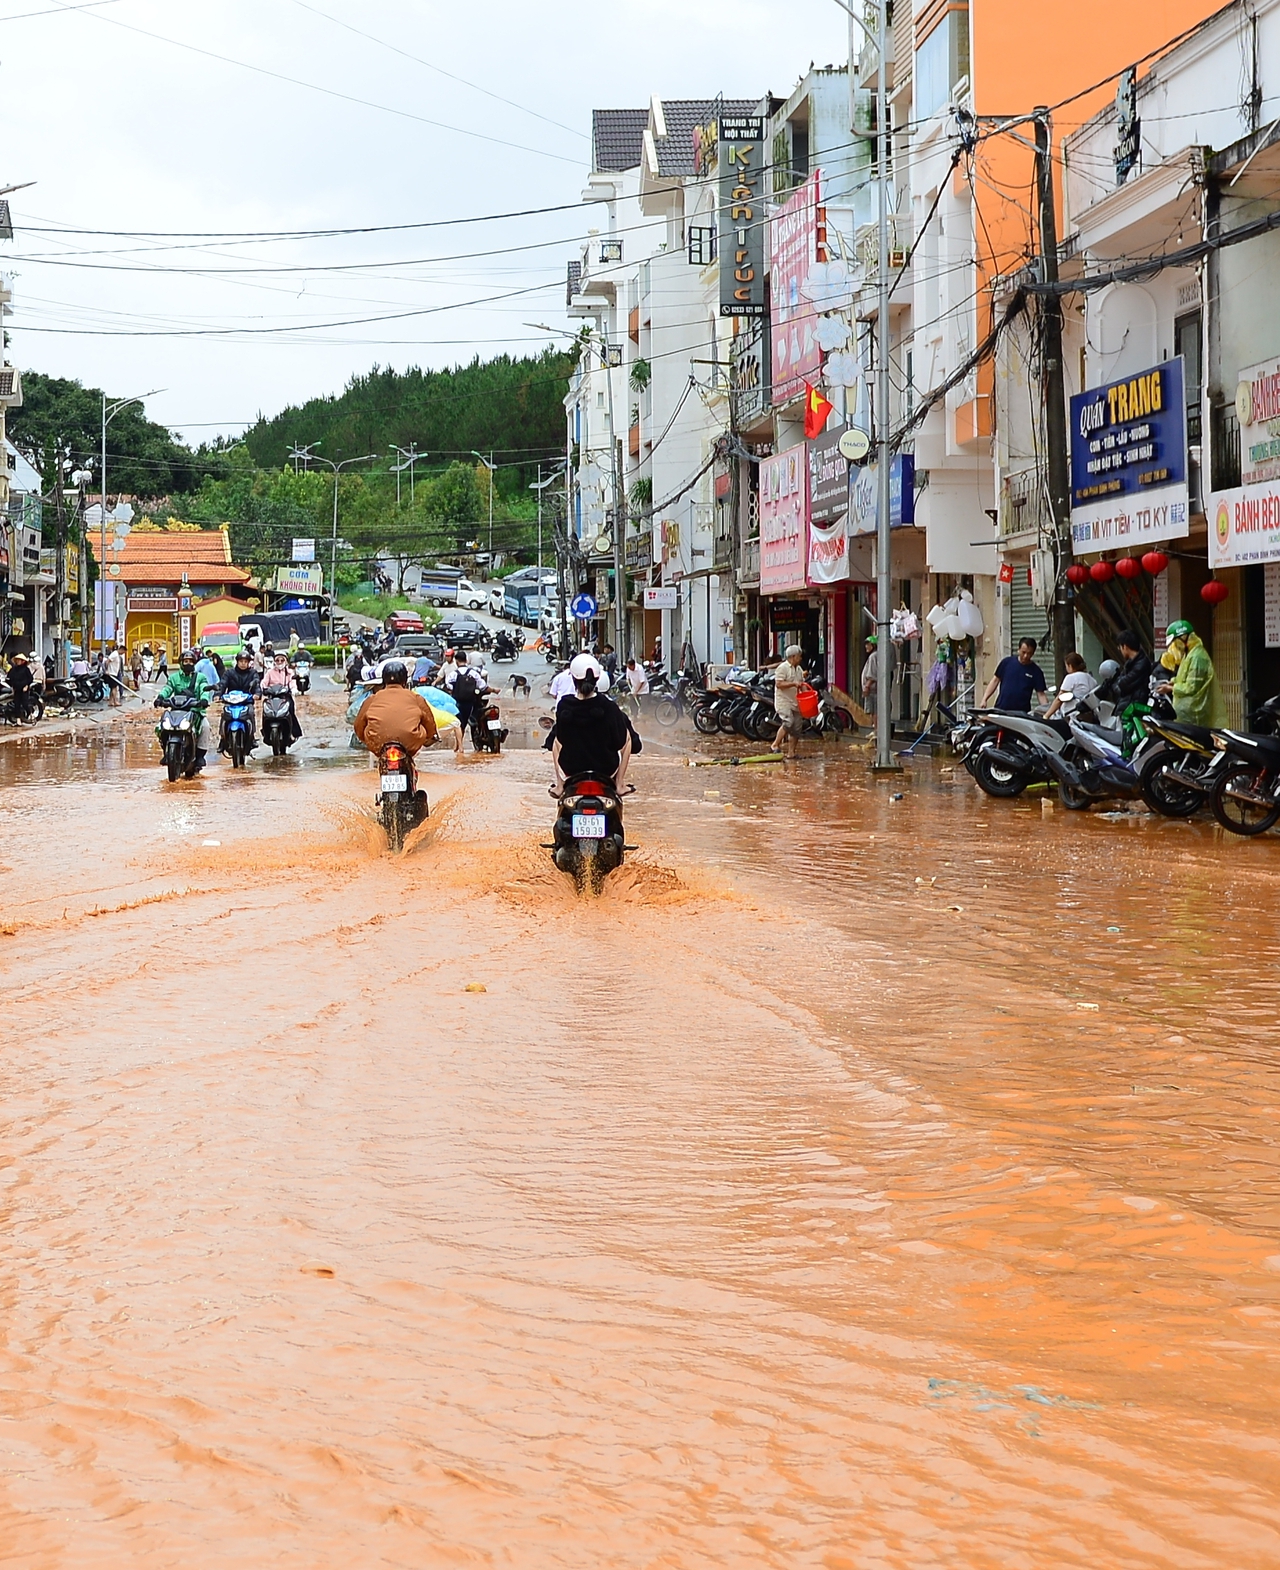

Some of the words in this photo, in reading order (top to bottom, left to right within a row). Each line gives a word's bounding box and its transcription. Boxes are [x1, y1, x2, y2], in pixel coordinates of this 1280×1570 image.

[722, 118, 747, 127] TRANG
[724, 128, 738, 140] NỘI
[740, 127, 758, 138] THẤT
[1080, 395, 1106, 438] QUÁN
[1108, 370, 1162, 425] TRANG
[1234, 494, 1260, 535] BÁNH
[1092, 515, 1100, 540] MÌ
[1100, 517, 1112, 541] VỊT
[1113, 508, 1131, 536] TIỀM
[280, 579, 303, 591] KHÔNG
[303, 580, 317, 592] TÊN
[575, 826, 603, 836] 159.39
